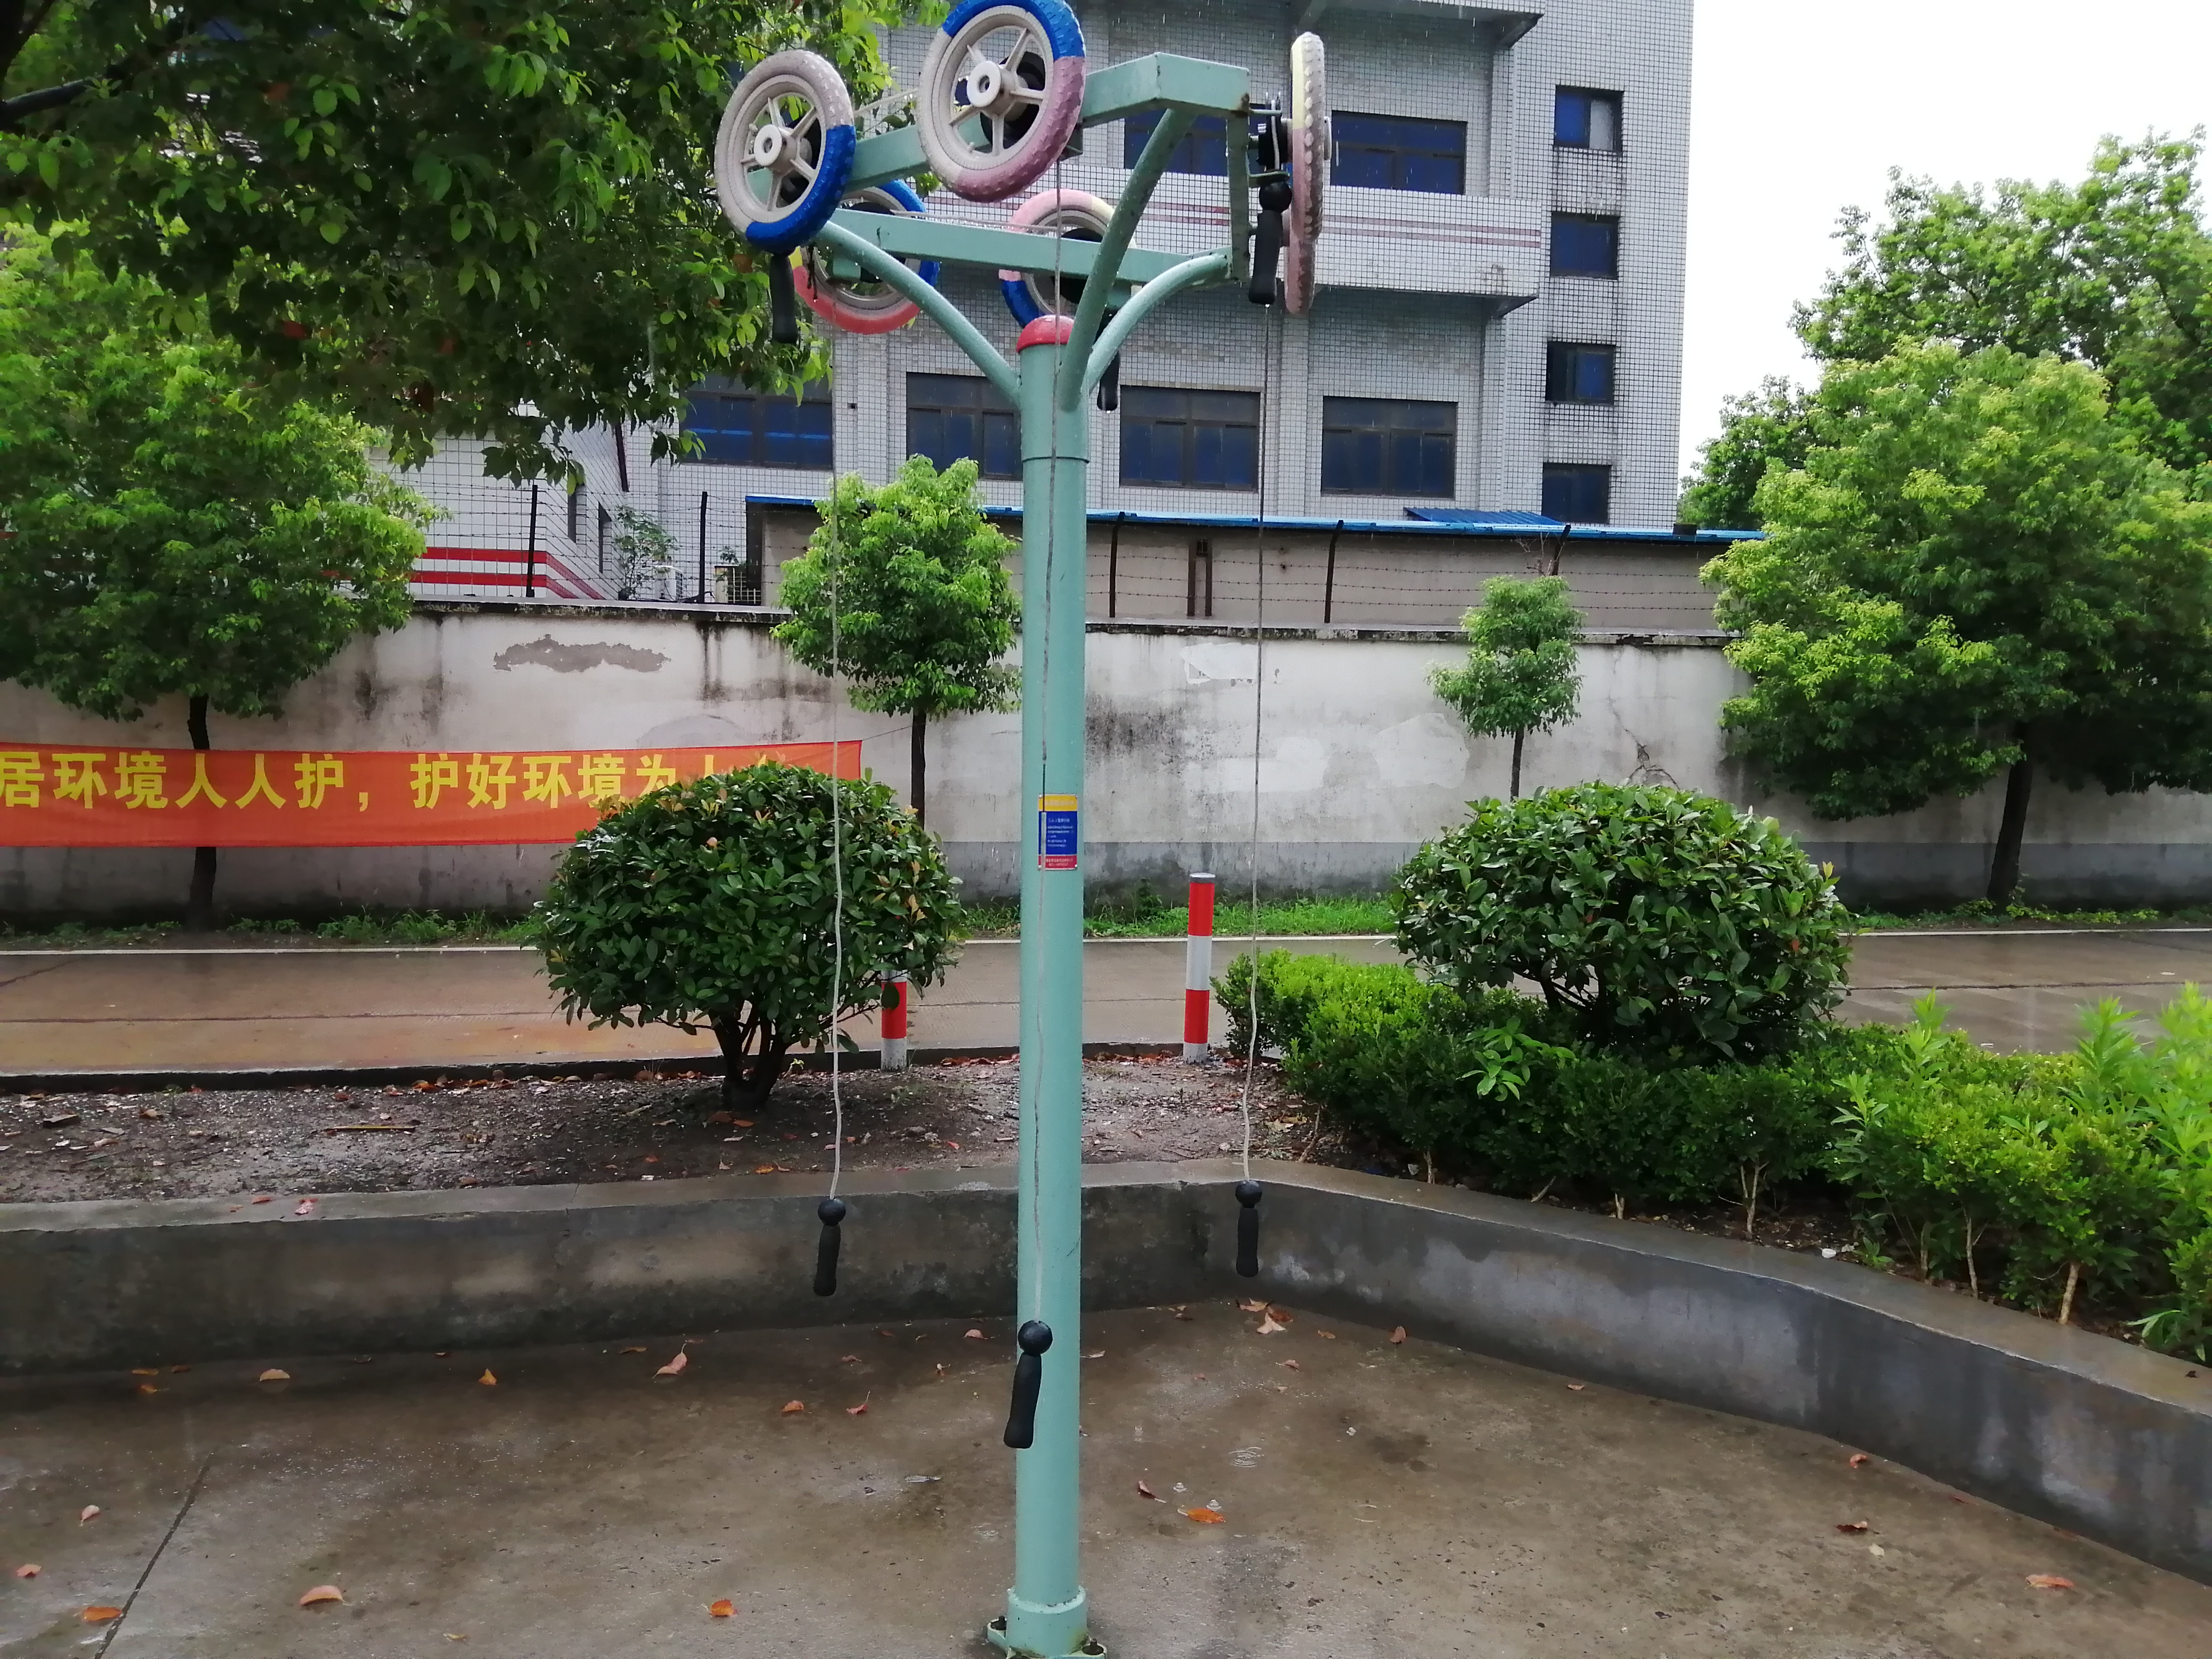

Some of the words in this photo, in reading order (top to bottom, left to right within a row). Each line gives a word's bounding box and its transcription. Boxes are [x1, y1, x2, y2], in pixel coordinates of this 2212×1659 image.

[0, 751, 766, 811] 居环境人人护，护好环境为
